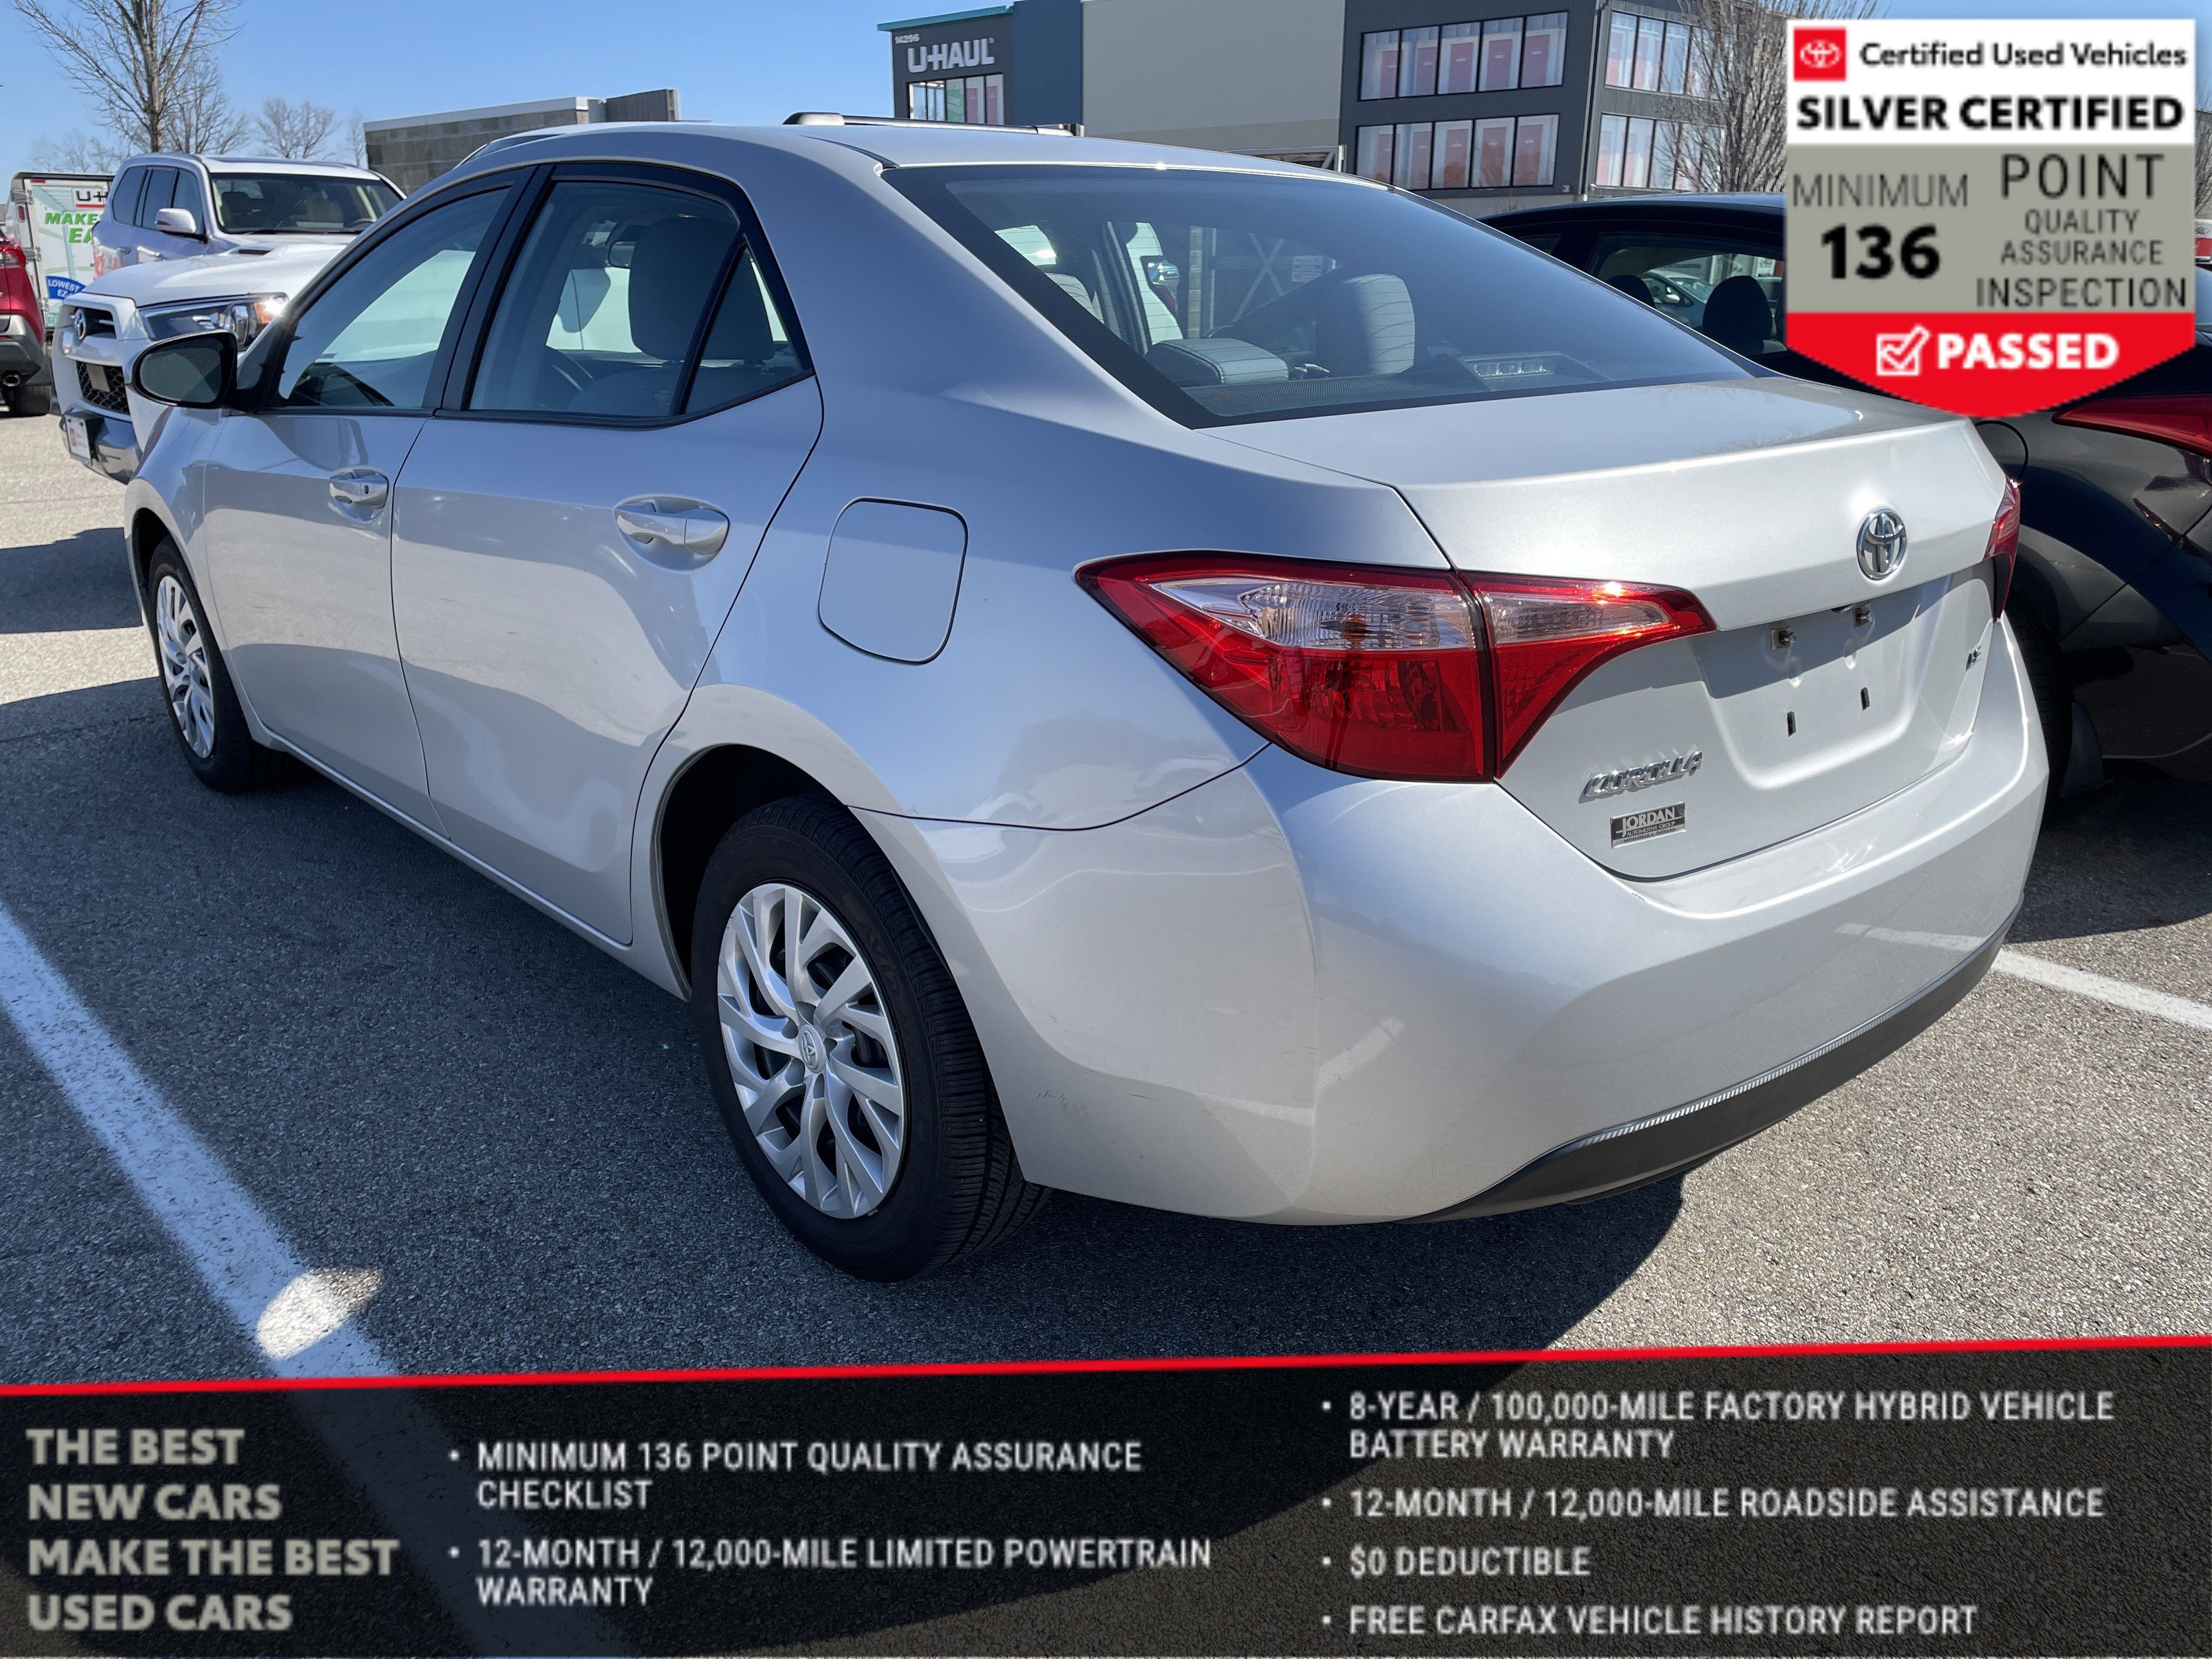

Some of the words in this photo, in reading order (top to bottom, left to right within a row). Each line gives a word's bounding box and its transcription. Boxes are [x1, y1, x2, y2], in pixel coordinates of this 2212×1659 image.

[907, 38, 995, 73] U-HAUL
[44, 212, 103, 225] MAKE
[47, 279, 81, 294] LOWEST
[1584, 751, 1702, 797] COROLLA
[1622, 806, 1675, 838] JORDAN
[1627, 825, 1658, 837] AUTOMOTIVE
